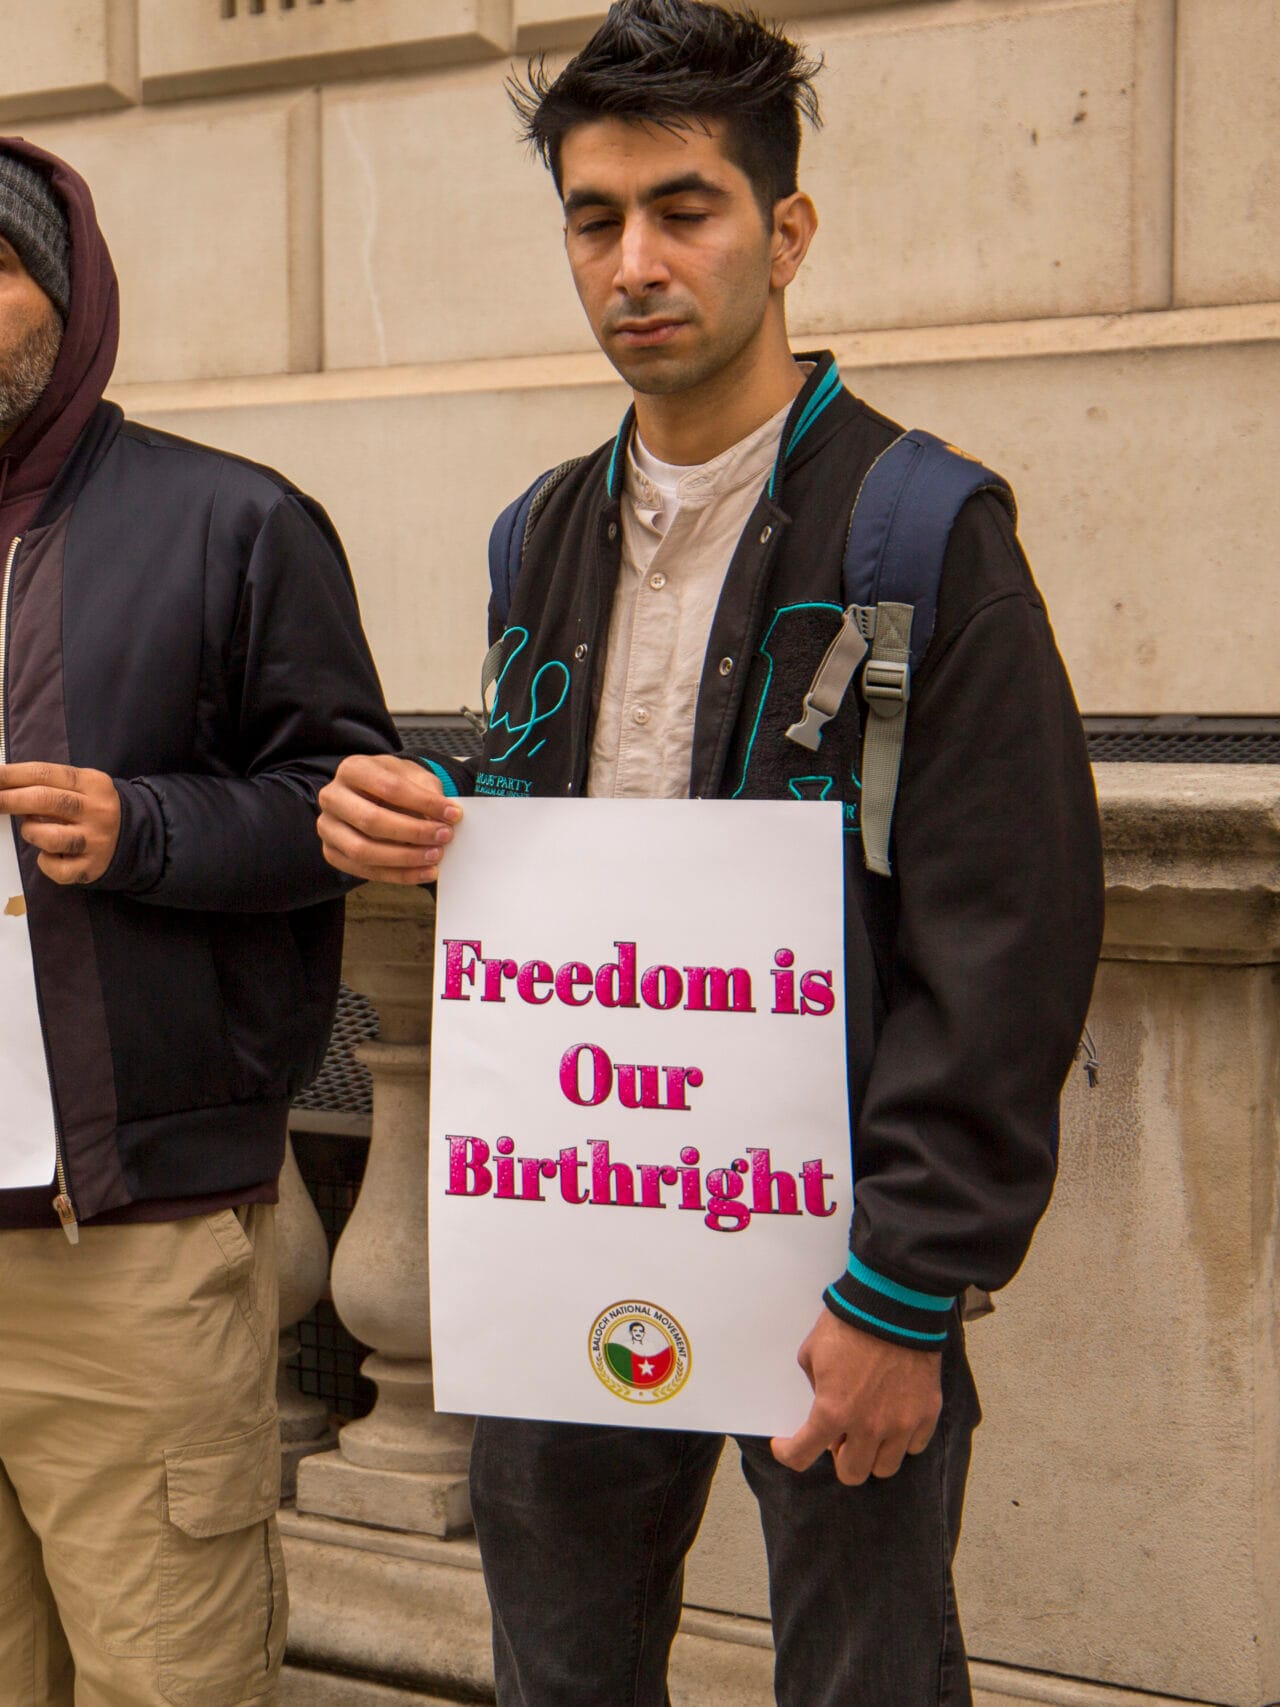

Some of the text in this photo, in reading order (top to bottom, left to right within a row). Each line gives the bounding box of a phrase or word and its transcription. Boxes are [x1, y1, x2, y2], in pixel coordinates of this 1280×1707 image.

[496, 775, 533, 793] PARTY
[441, 938, 837, 1016] Freedom is
[558, 1042, 704, 1111] Our
[444, 1134, 838, 1233] Birthright
[592, 1305, 687, 1358] BALOCH NATIONAL MOVEMENT
